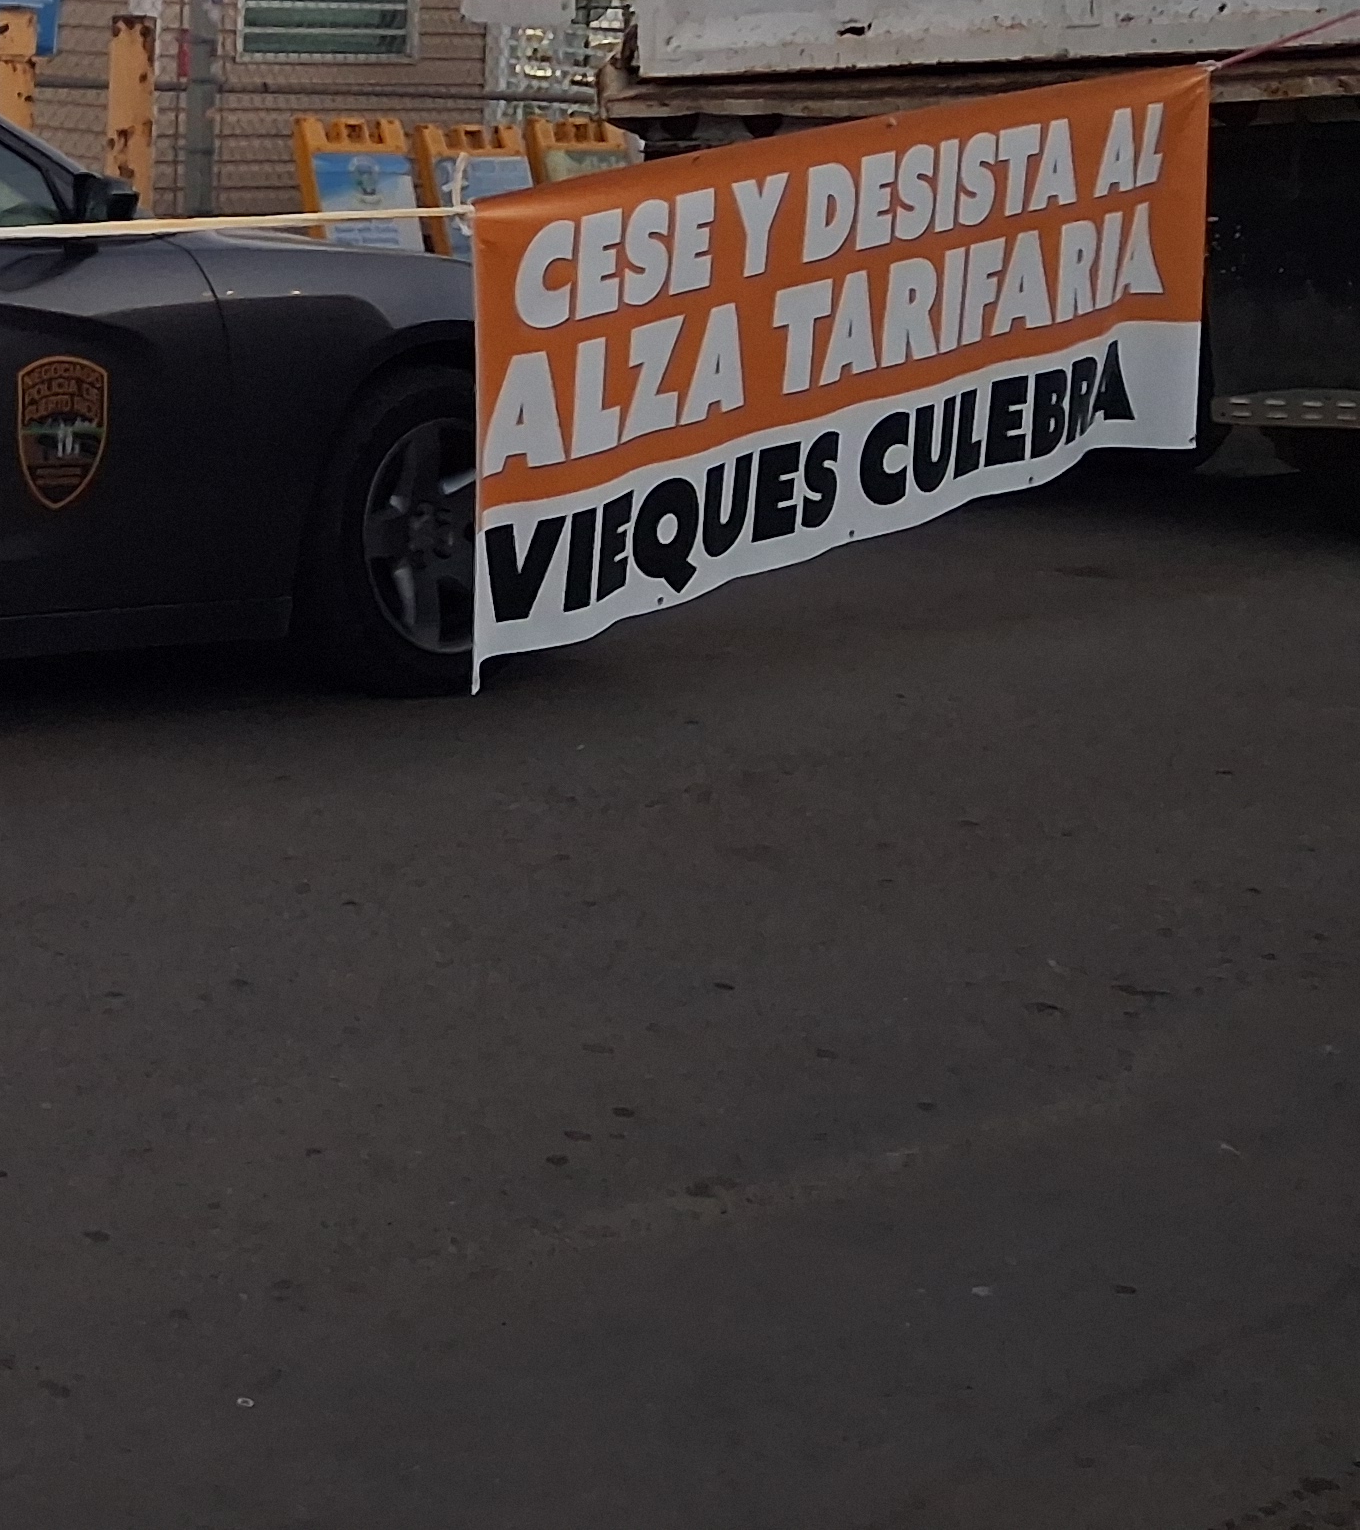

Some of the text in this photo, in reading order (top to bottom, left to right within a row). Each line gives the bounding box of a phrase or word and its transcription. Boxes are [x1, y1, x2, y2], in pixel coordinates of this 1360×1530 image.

[482, 201, 1164, 480] ALZA TARIFARIA
[515, 102, 1164, 329] CESE Y DESISTA AL
[483, 340, 1136, 623] VIEQUES CULEBRA
